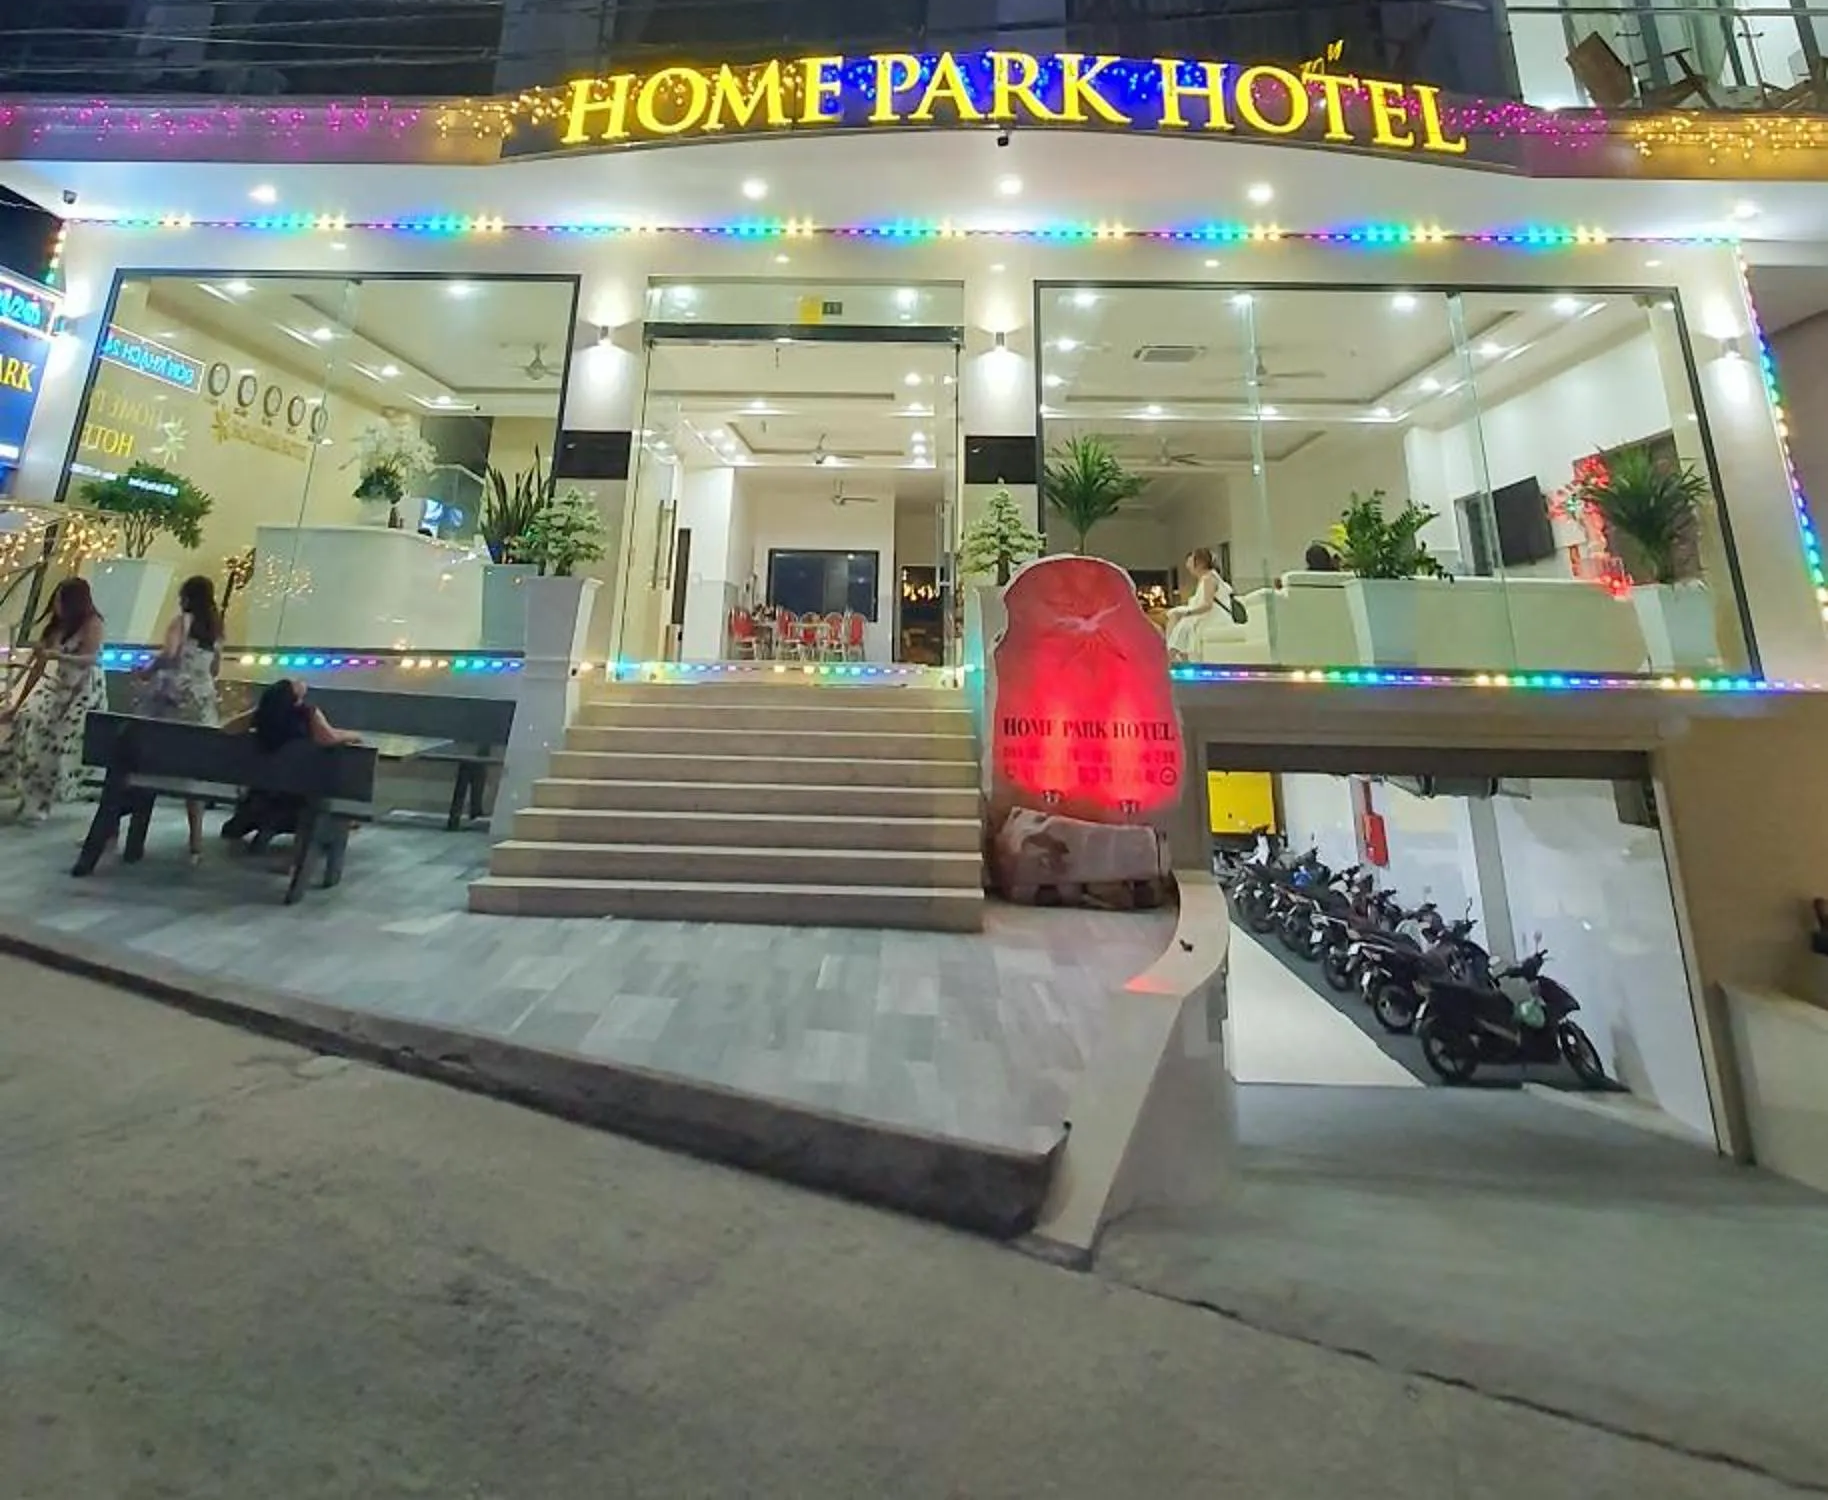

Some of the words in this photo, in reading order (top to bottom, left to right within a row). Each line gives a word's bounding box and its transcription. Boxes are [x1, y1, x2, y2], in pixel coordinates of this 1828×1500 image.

[559, 56, 846, 145] HOME
[867, 51, 1133, 126] PARK
[1155, 58, 1469, 154] HOTEL
[1063, 719, 1108, 739] PARK
[1113, 722, 1176, 741] HOTEL
